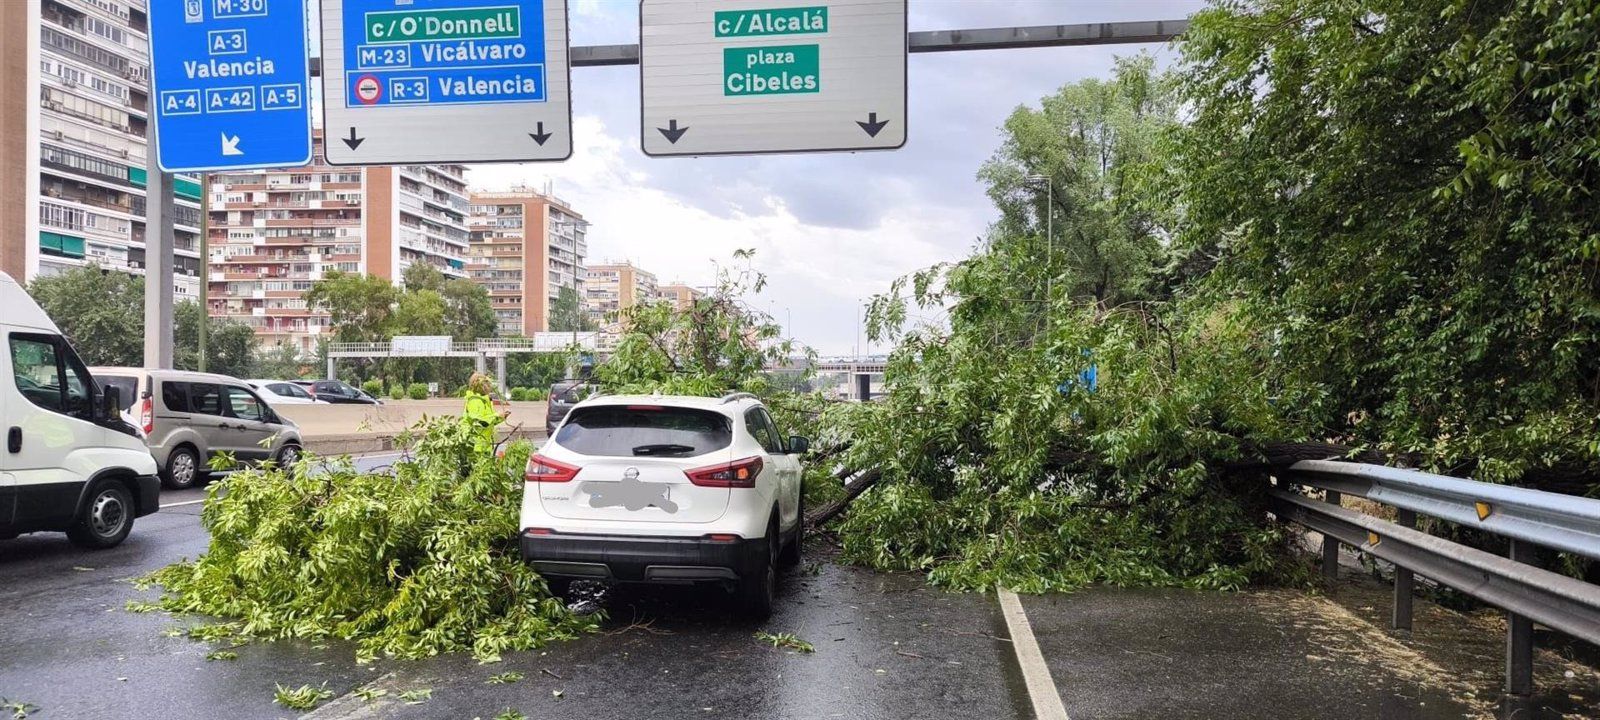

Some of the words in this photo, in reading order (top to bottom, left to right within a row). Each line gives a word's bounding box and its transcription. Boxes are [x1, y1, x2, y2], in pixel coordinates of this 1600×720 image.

[217, 0, 263, 13] M-30
[717, 10, 824, 34] c/Alcalá
[213, 34, 242, 50] A-3
[361, 49, 407, 65] M-23
[420, 41, 526, 63] Vicálvaro
[746, 50, 795, 68] plaza
[184, 56, 274, 79] Valencia
[393, 82, 425, 97] R-3
[438, 74, 536, 96] Valencia
[726, 72, 817, 92] Cibeles
[166, 95, 196, 110] A-4
[210, 92, 251, 107] A-42
[266, 89, 296, 104] A-5
